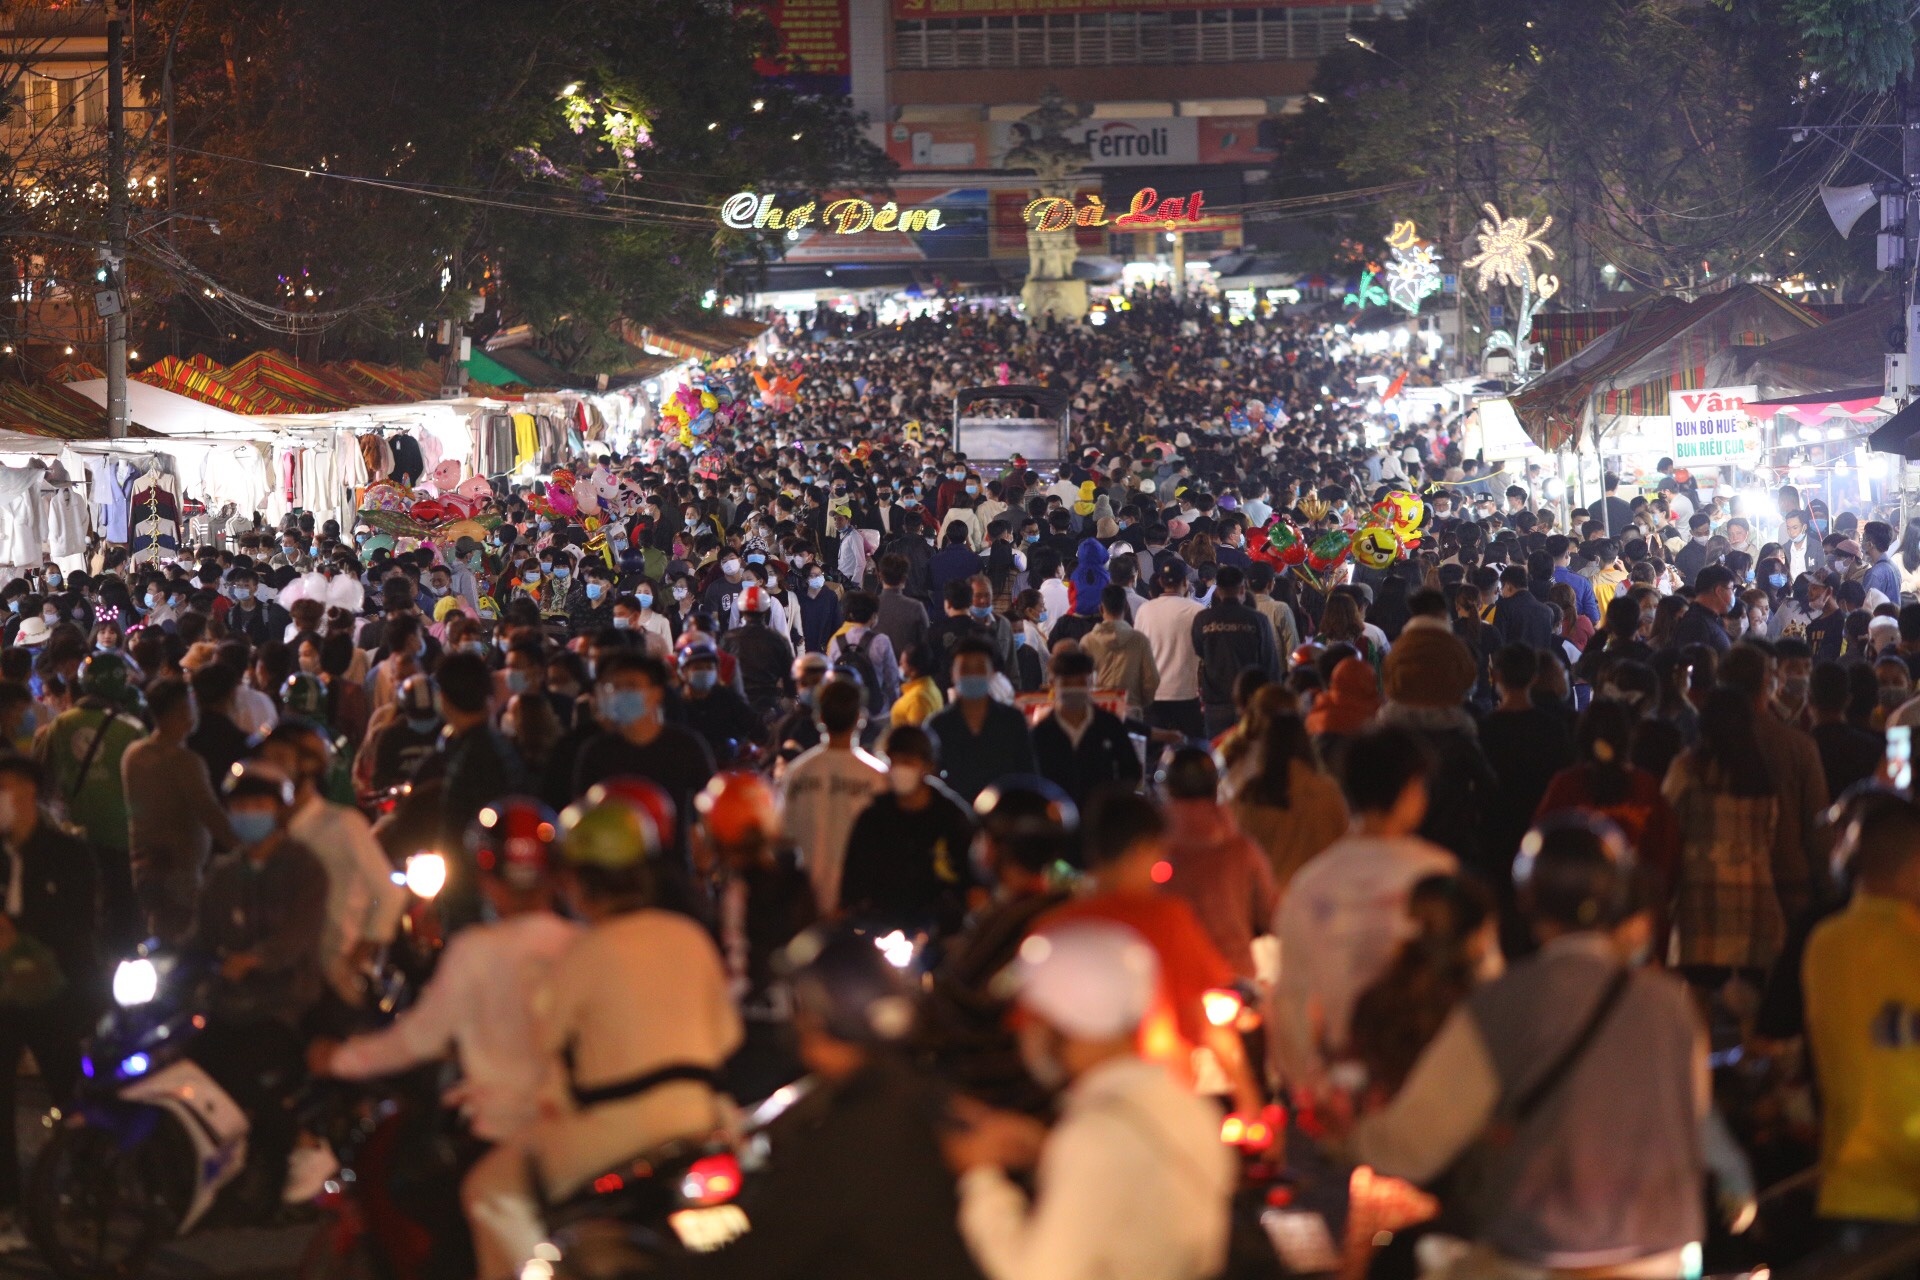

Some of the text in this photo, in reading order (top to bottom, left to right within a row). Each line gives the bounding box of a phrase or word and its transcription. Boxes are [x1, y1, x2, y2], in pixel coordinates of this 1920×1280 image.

[1085, 127, 1168, 157] Ferroli
[721, 187, 1205, 240] Chợ Đêm Đà Lạt
[1681, 392, 1744, 414] Vân
[1700, 416, 1714, 435] BÒ
[1700, 437, 1723, 456] RIÊU
[1725, 439, 1745, 455] CUA
